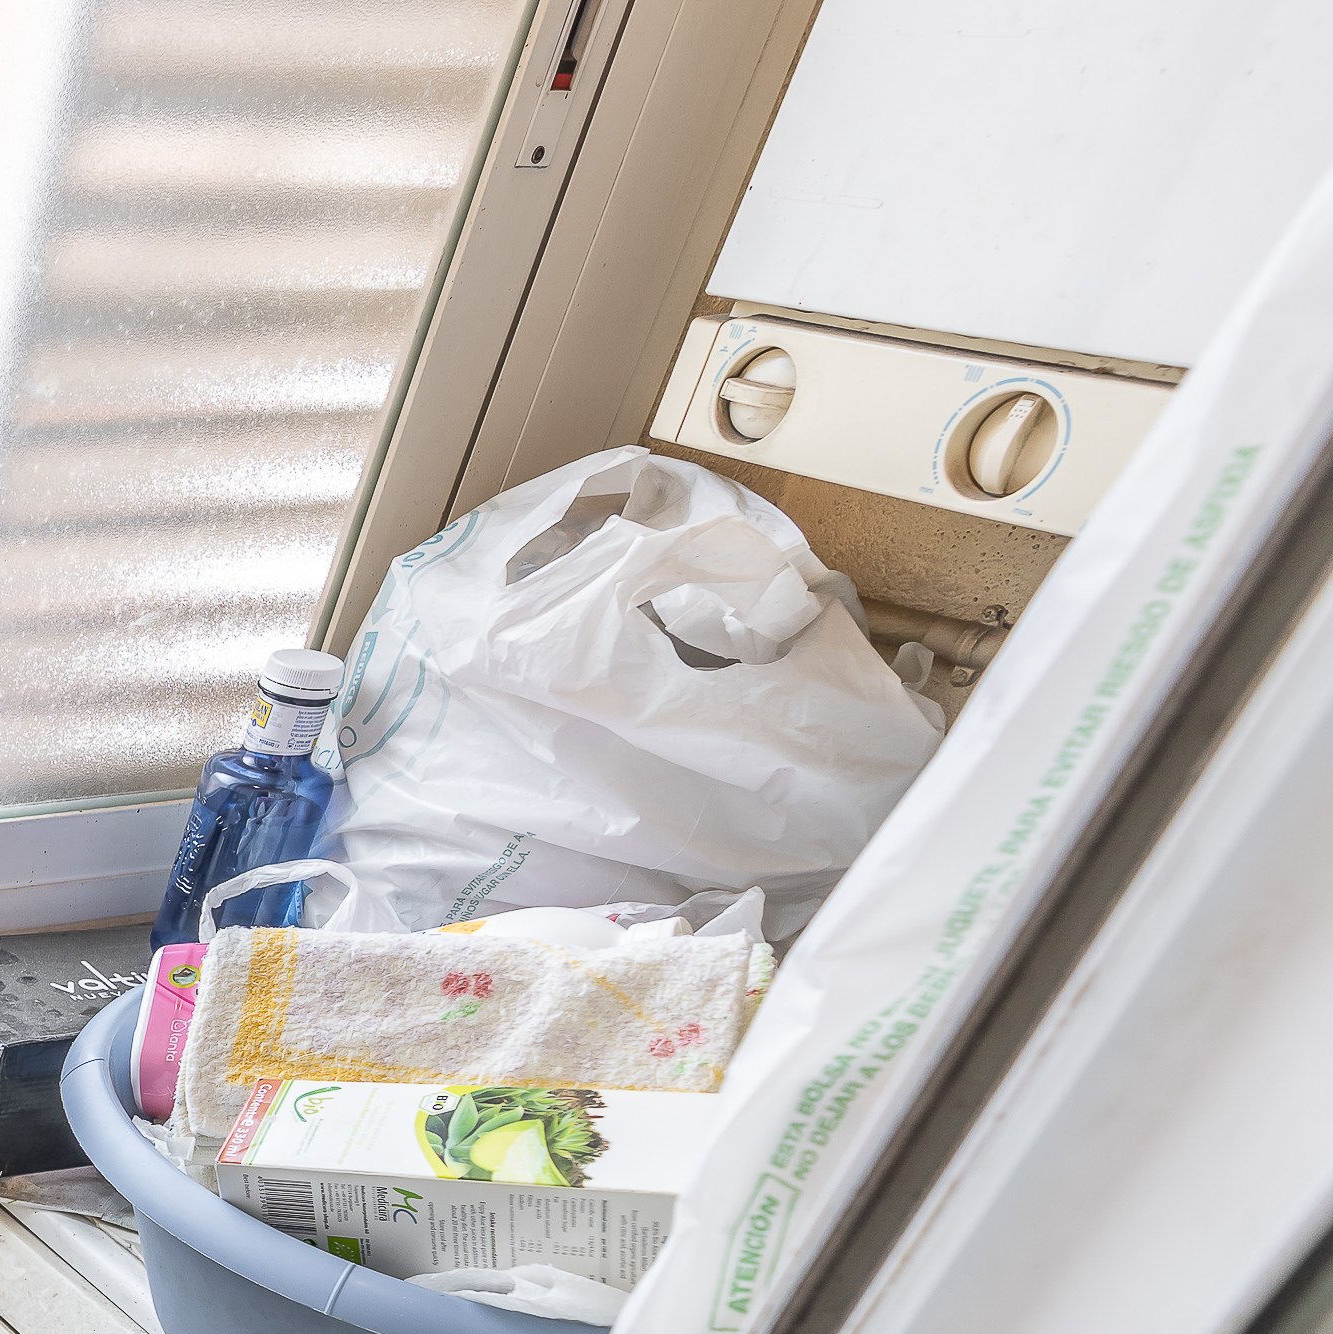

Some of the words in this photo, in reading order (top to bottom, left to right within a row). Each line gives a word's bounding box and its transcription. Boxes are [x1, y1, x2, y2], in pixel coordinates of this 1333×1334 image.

[444, 894, 467, 922] PARA
[301, 1095, 334, 1117] bio
[431, 1094, 448, 1111] BIO
[229, 1125, 248, 1144] 330
[767, 1117, 811, 1172] ESTA
[375, 1185, 390, 1222] Medicura
[390, 1186, 423, 1224] MC
[487, 1211, 497, 1227] Intake
[726, 1192, 783, 1315] ATENCIÓN
